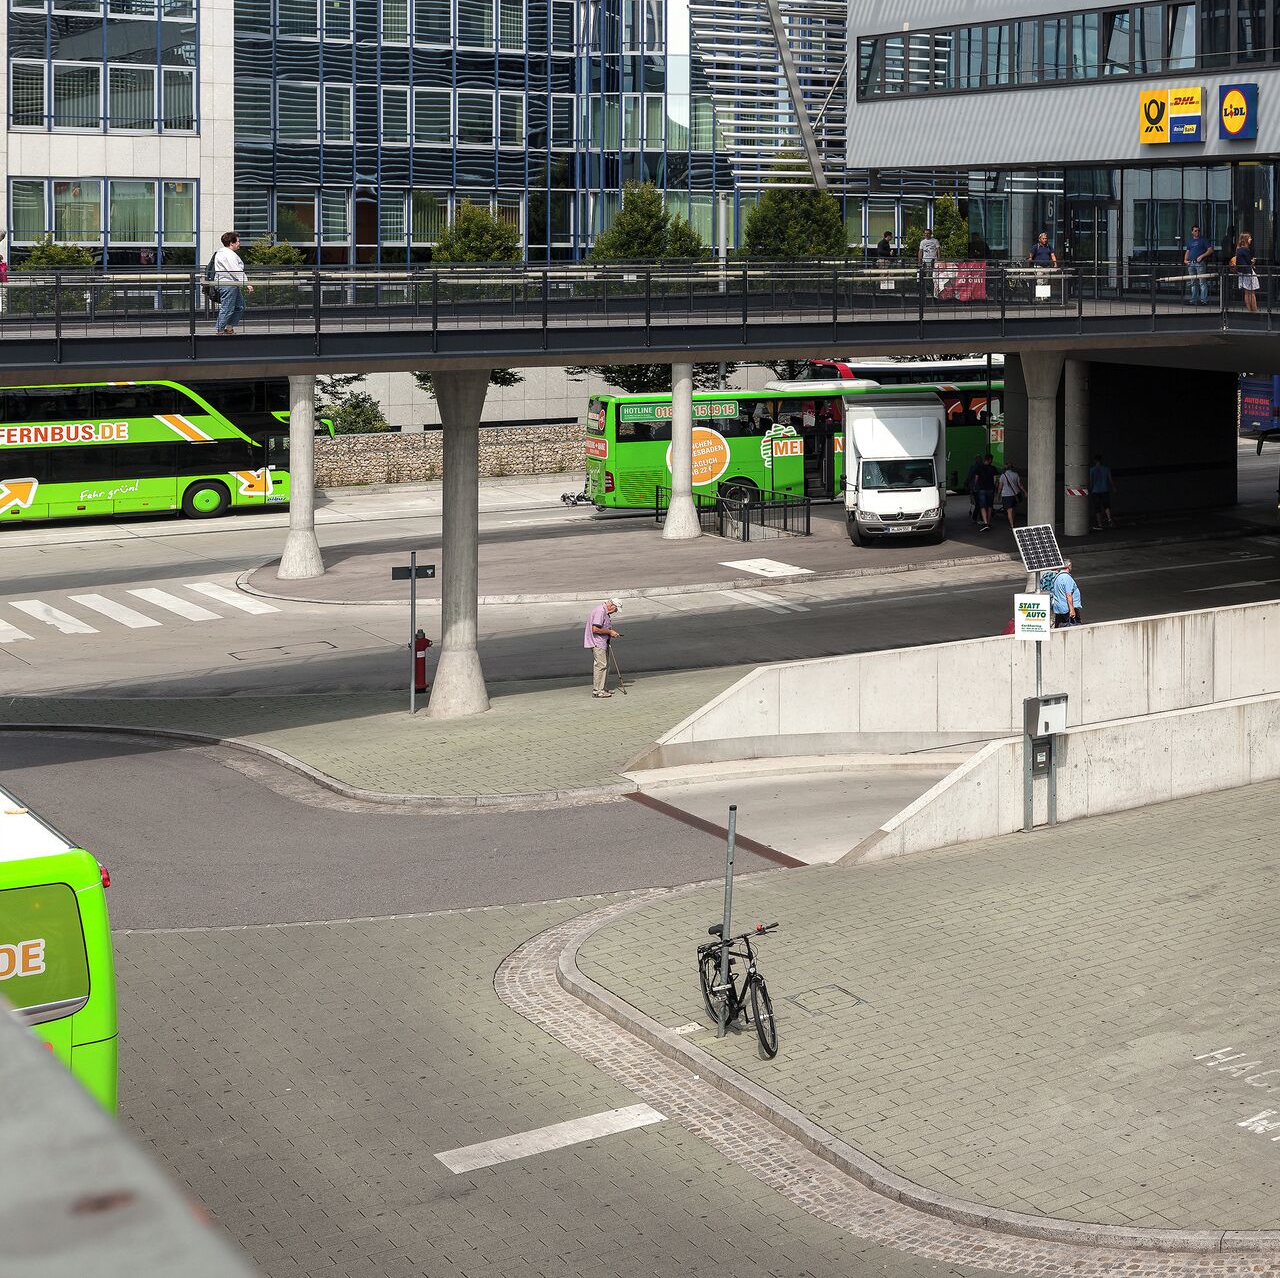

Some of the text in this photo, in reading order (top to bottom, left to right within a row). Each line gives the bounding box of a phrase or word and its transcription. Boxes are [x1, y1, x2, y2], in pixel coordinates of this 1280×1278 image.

[1173, 96, 1197, 106] DHL
[624, 407, 653, 415] HOTLINE
[655, 406, 673, 418] 018
[722, 403, 735, 416] 15
[692, 444, 724, 457] ESBADEN
[80, 479, 139, 502] Fahr grün!
[1025, 611, 1047, 619] AUTO
